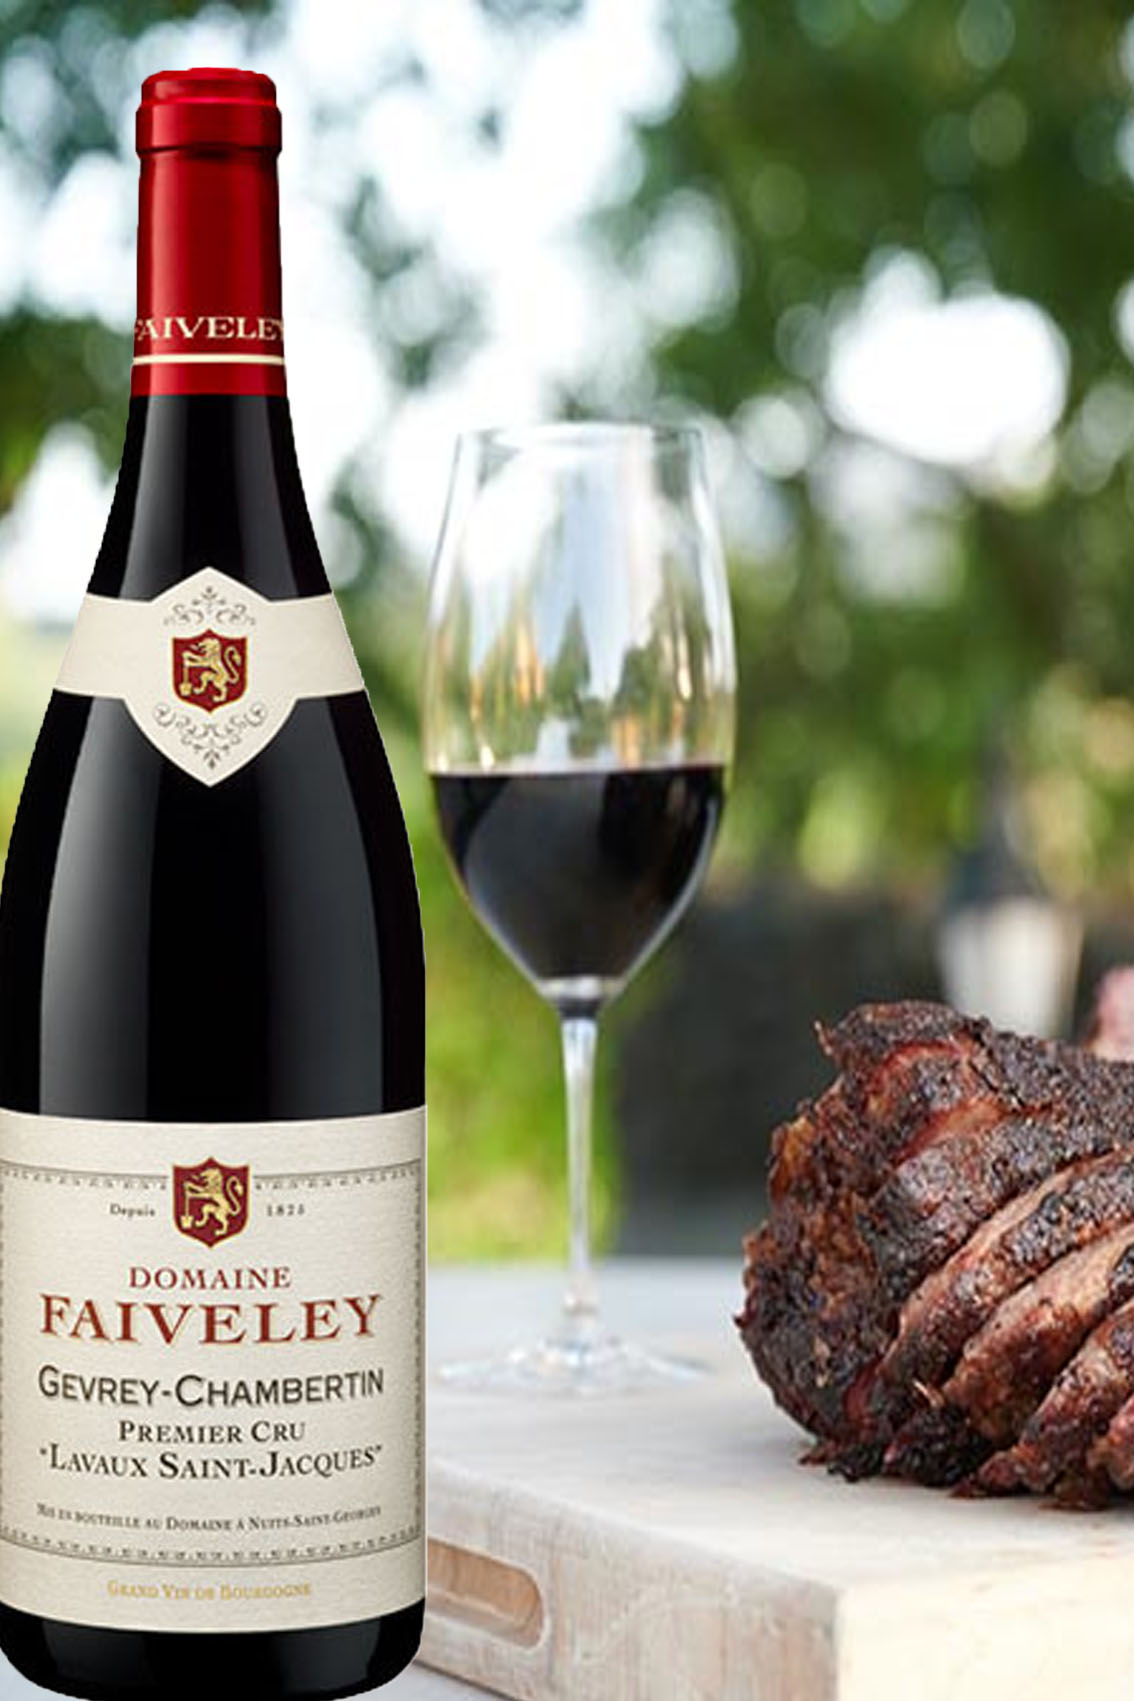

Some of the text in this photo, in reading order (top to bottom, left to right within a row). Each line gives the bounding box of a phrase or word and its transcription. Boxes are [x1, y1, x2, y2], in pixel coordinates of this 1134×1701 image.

[110, 1203, 155, 1218] Depuis
[129, 1266, 291, 1290] DOMAINE
[39, 1293, 382, 1345] FAIVELEY
[38, 1365, 384, 1407] GEVREY-CHAMBERTIN
[119, 1419, 306, 1444] PREMIER CRU
[75, 1511, 140, 1529] BOUTEILLE
[146, 1518, 163, 1530] AU
[166, 1516, 231, 1531] DOMAINE
[107, 1580, 158, 1599] GRAND
[162, 1583, 190, 1599] VIN
